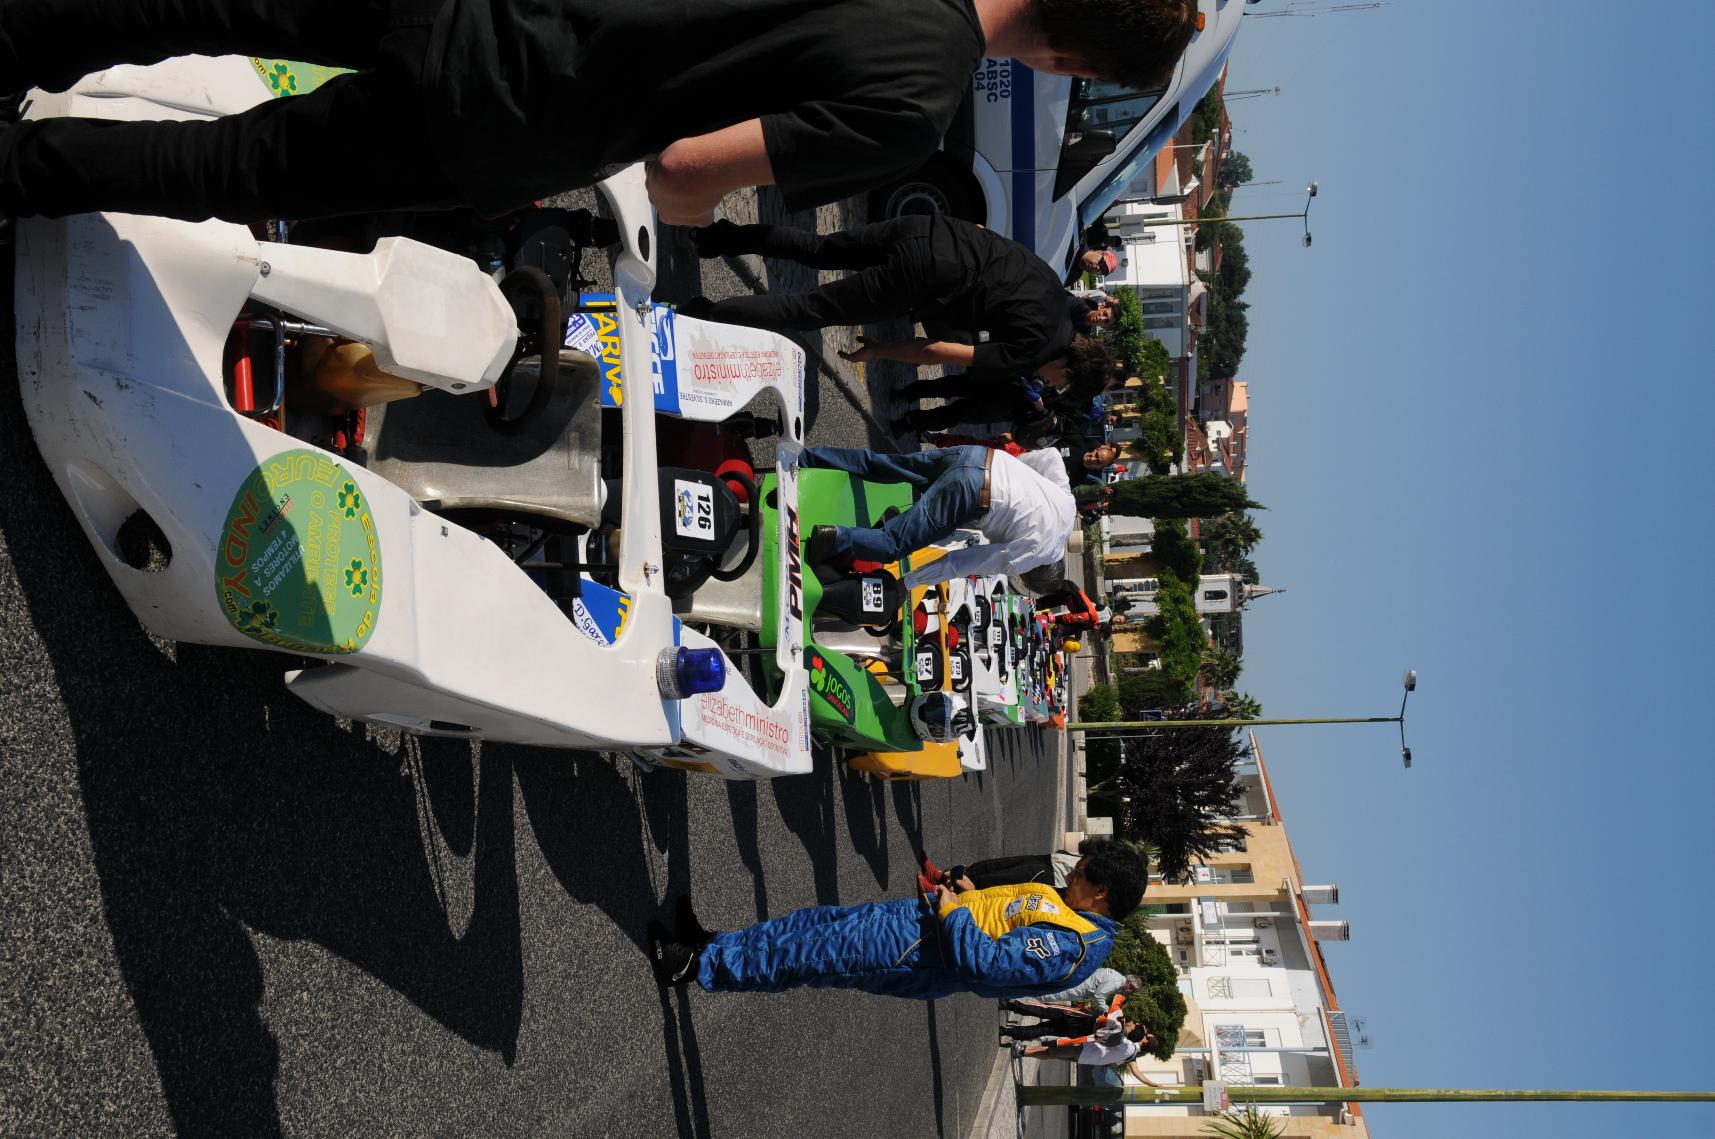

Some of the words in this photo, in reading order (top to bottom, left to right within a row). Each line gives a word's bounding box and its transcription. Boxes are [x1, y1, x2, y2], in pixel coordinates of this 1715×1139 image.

[975, 72, 986, 91] 04
[987, 58, 998, 103] ABSC
[1000, 60, 1010, 98] 1020
[310, 490, 325, 508] O
[698, 494, 711, 530] 126
[250, 536, 285, 573] TEMPOS
[261, 534, 297, 578] MOTORES
[263, 544, 305, 596] UTILIZAMOS
[298, 511, 323, 626] AMBIENTE
[320, 510, 342, 616] PROTEGE
[360, 512, 379, 604] Escola
[786, 504, 802, 621] PMH
[254, 577, 263, 587] A
[873, 583, 882, 608] 89
[355, 610, 374, 638] de
[925, 657, 932, 675] 67
[826, 674, 850, 710] JOGOS
